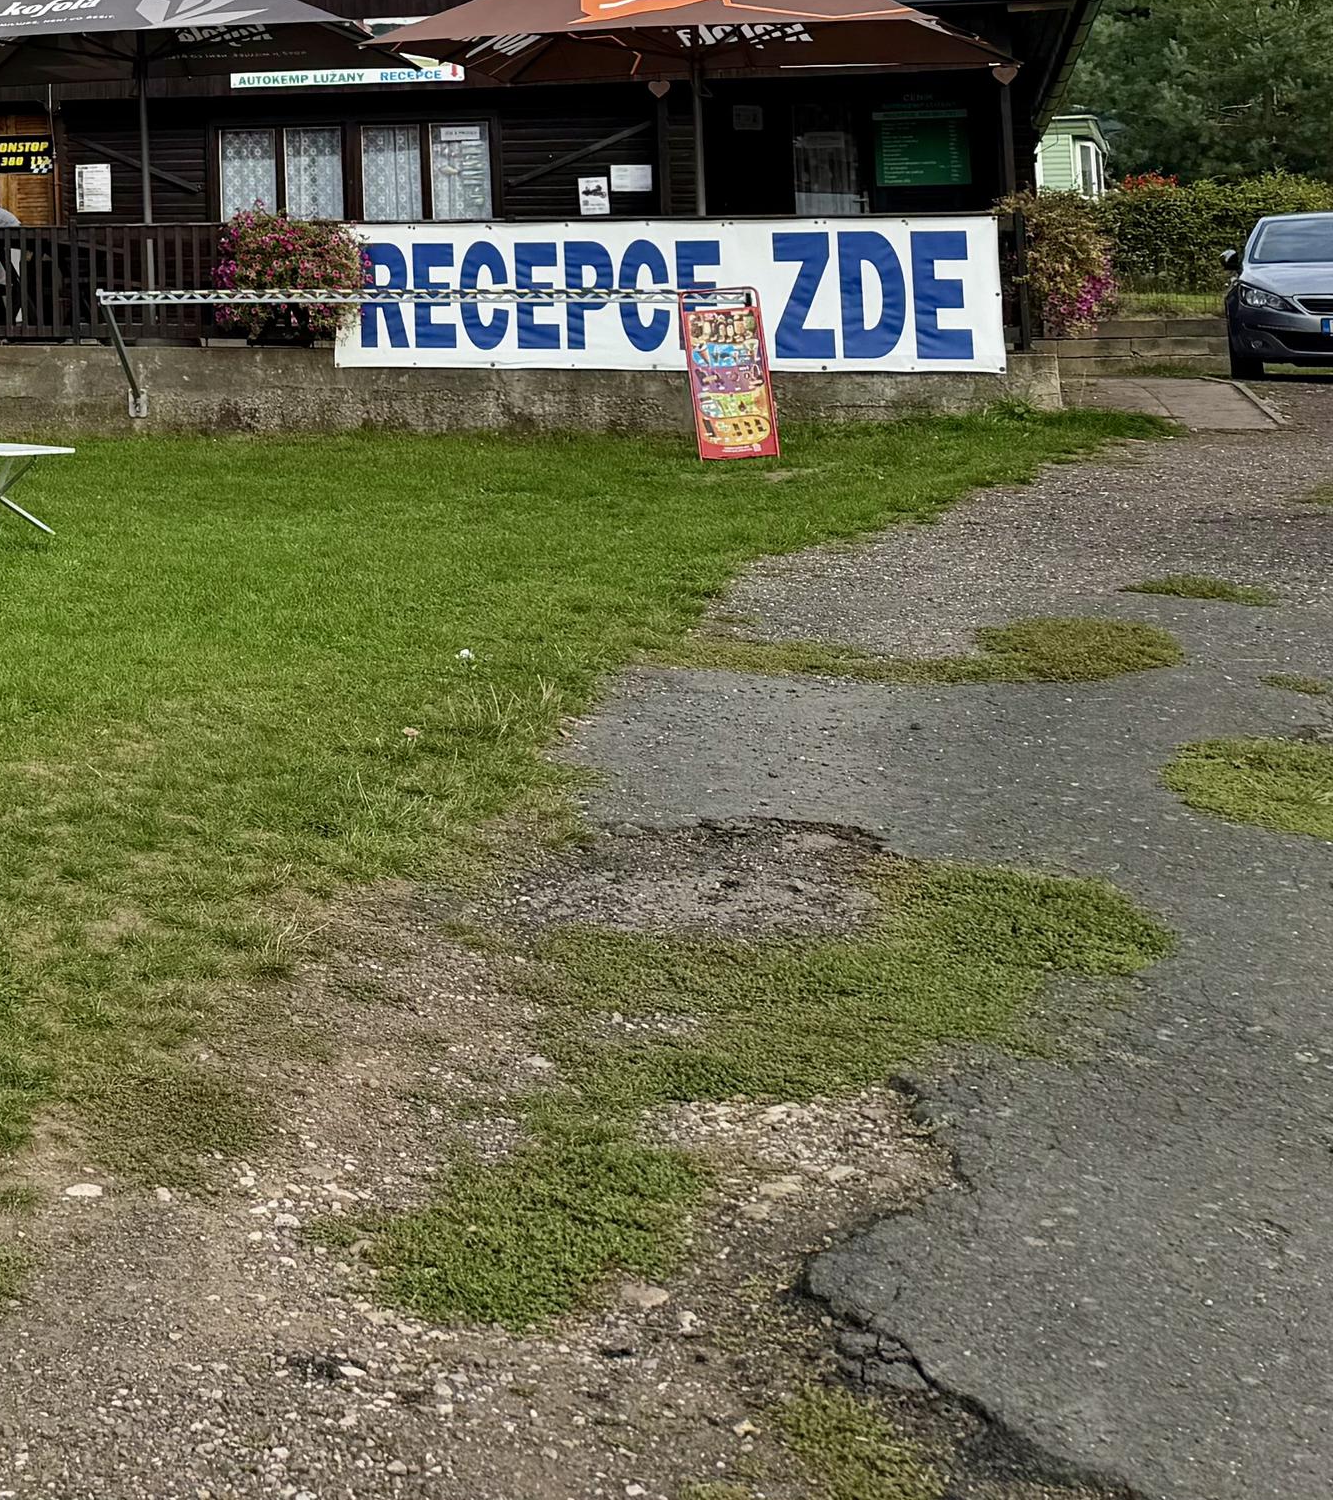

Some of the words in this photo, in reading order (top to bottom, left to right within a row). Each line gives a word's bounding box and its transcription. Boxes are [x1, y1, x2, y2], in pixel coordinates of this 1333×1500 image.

[238, 74, 309, 86] AUTOKEMP
[313, 71, 365, 84] LUŽANY
[379, 69, 443, 82] RECEPCE
[772, 230, 974, 360] ZDE
